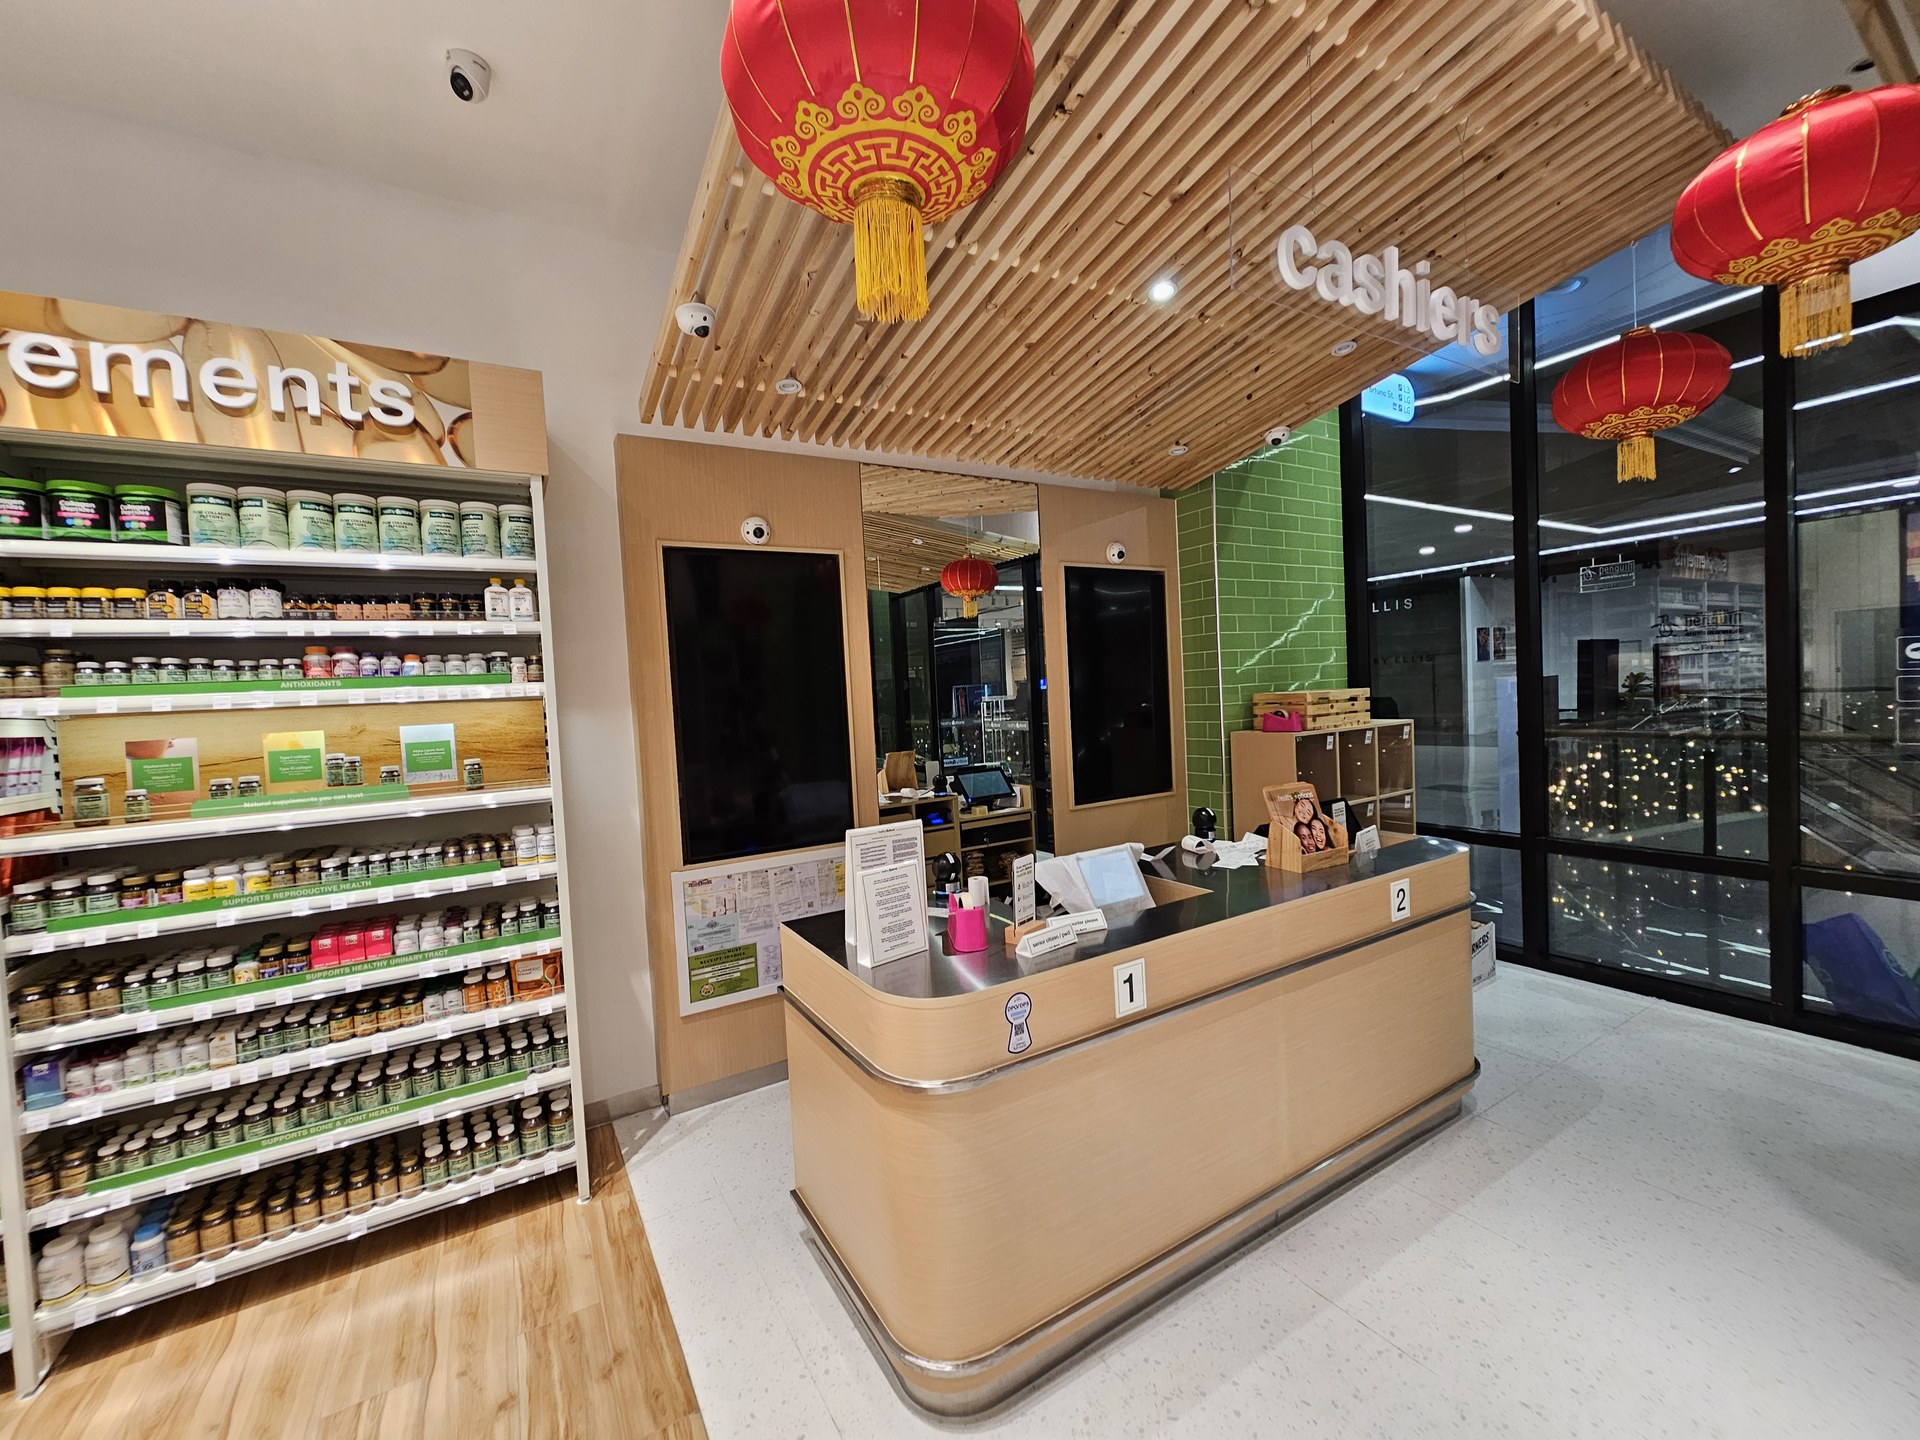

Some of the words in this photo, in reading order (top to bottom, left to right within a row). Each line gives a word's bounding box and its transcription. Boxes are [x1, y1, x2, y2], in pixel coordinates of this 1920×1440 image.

[1277, 224, 1500, 356] Cashiers
[7, 332, 417, 428] ements
[1372, 598, 1413, 613] LLIS
[281, 680, 342, 689] ANTIOXIDANTS
[272, 797, 319, 807] supplements
[222, 893, 271, 907] SUPPORTS
[272, 886, 339, 900] REPRODUCTIVE
[340, 880, 372, 892] HEALTH
[1396, 887, 1407, 913] 2
[305, 967, 351, 981] SUPPORTS
[351, 960, 388, 972] HEALTHY
[389, 953, 423, 966] URINARY
[424, 949, 449, 959] TRACT
[1123, 973, 1135, 1003] 1
[261, 1130, 308, 1147] SUPPORTS
[309, 1123, 334, 1134] BONE
[343, 1114, 368, 1125] JOINT
[368, 1105, 400, 1118] HEALTH
